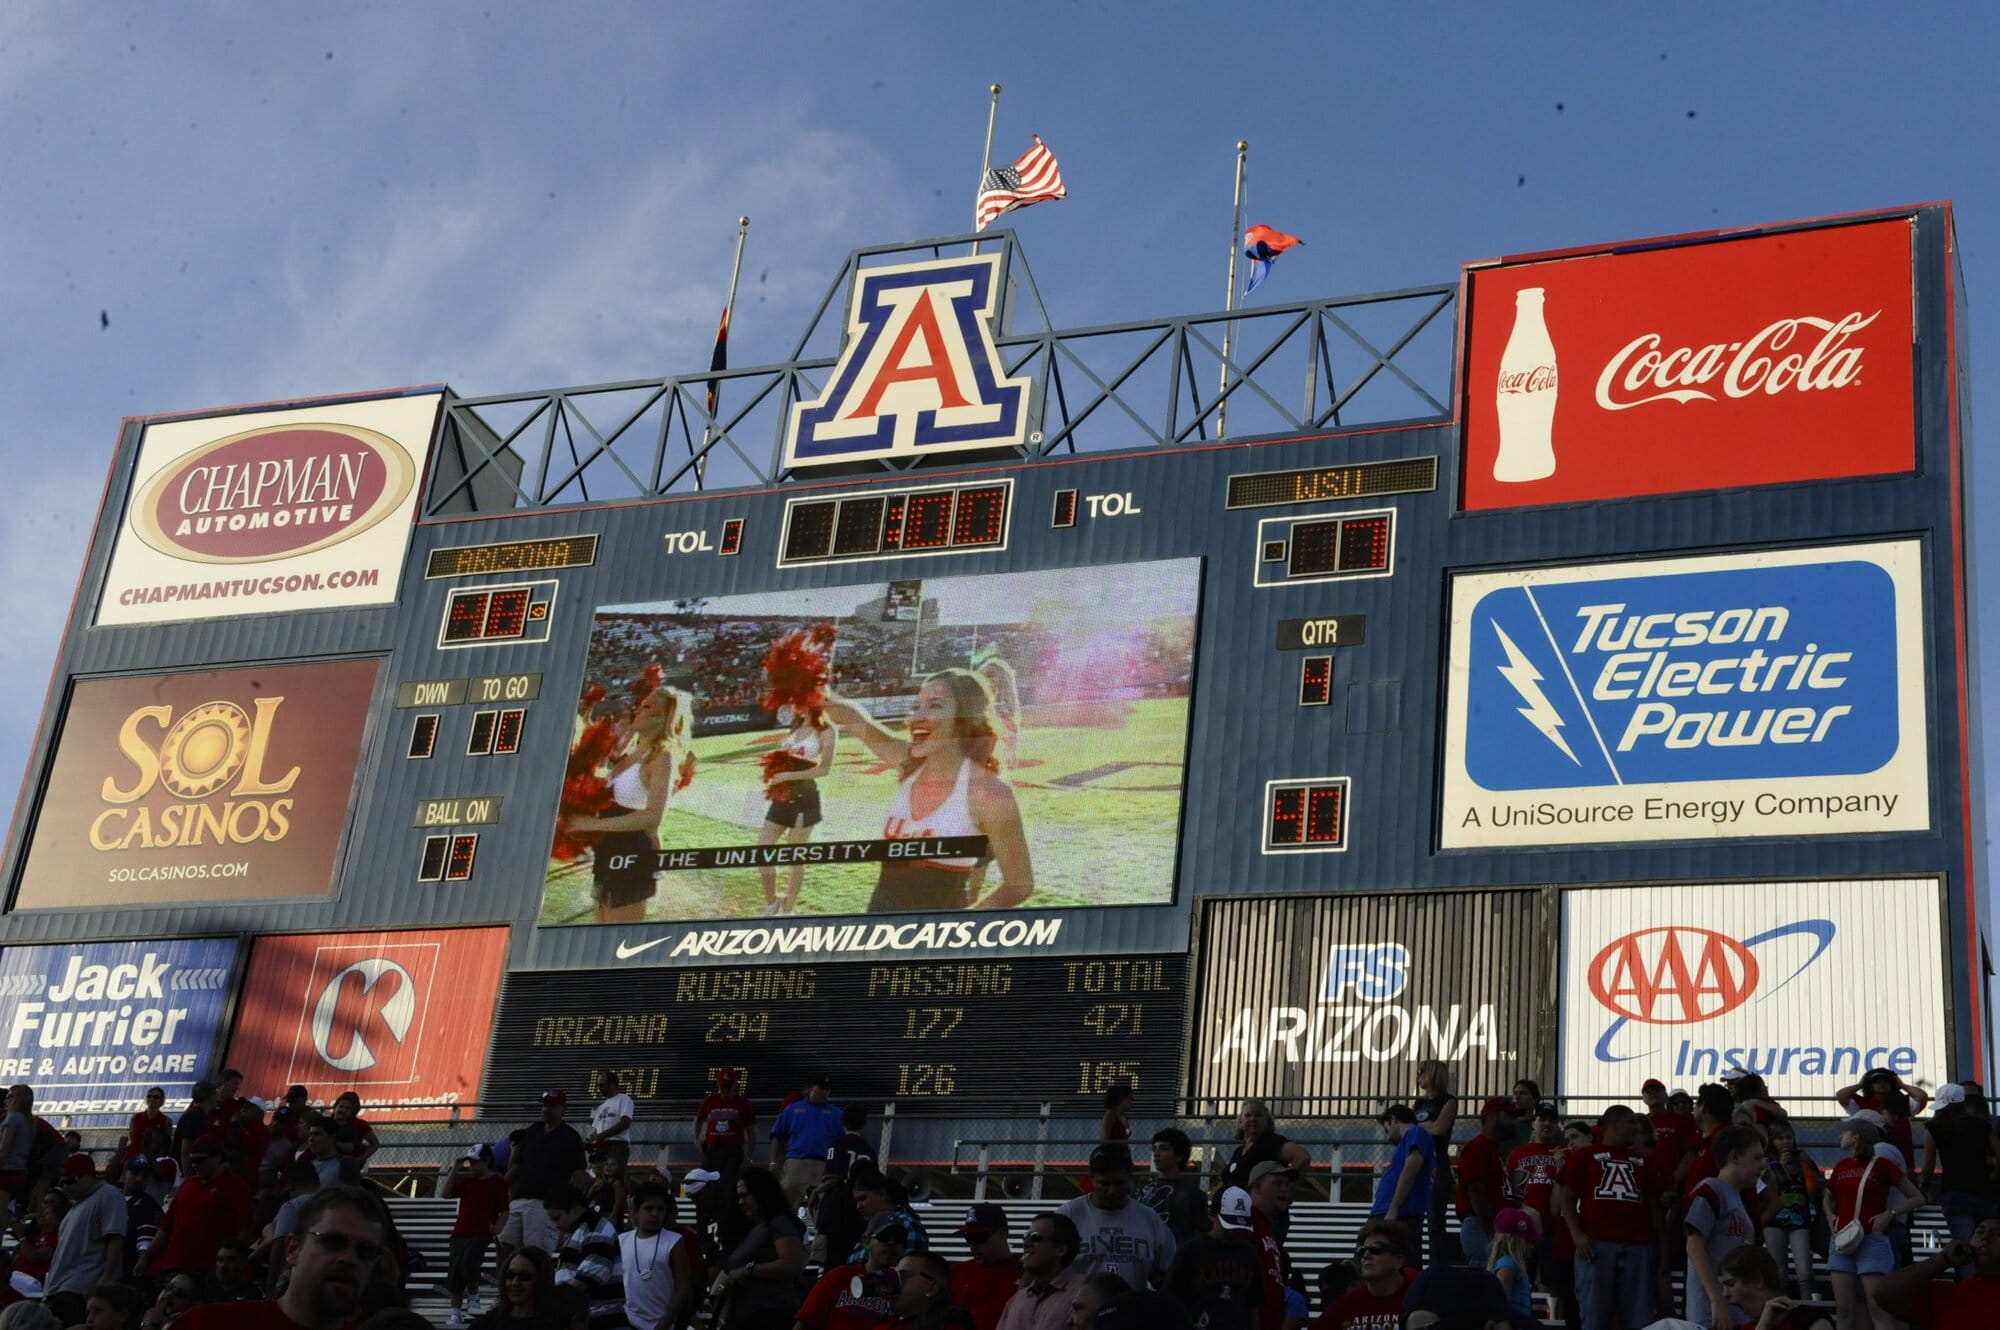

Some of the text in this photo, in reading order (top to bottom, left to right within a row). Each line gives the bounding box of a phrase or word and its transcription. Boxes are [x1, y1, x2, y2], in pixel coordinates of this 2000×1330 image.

[1595, 310, 1881, 410] Coca-Cola
[1498, 365, 1557, 394] Coca-Cola
[179, 452, 368, 515] CHAPMAN
[1295, 469, 1362, 500] WSU
[175, 504, 353, 536] AUTOMOTIVE
[1086, 492, 1141, 518] TOL
[455, 541, 570, 574] ARIZONA
[665, 530, 713, 554] TOL
[120, 569, 379, 606] CHAPMANTUCSON.COM
[451, 591, 529, 638] 48
[1302, 620, 1338, 645] QTR
[1572, 603, 1789, 653] Tucson
[483, 676, 529, 700] TO GO
[1593, 643, 1853, 701] Electric
[414, 682, 450, 705] DWN
[1616, 702, 1852, 752] Power
[102, 696, 301, 804] SOL
[90, 799, 293, 850] CASINOS
[425, 800, 489, 825] BALL ON
[1462, 793, 1898, 828] A UniSource Energy Company
[108, 863, 248, 882] SOLCASINOS.COM
[609, 841, 962, 871] OF THE UNIVERSITY BELL.
[669, 919, 1063, 957] ARIZONAWILDCATS.COM
[48, 953, 171, 1002] Jack
[675, 960, 1171, 1002] RUSHING PASSING TOTAL
[1318, 942, 1410, 1003] FS
[1605, 927, 1743, 1023] AAA
[8, 1002, 188, 1049] Furrier
[533, 1004, 1144, 1046] ARIZONA 294 177 471
[1212, 1004, 1498, 1063] ARIZONA
[38, 1057, 55, 1076] &
[62, 1056, 127, 1076] AUTO
[133, 1054, 197, 1073] CARE
[1675, 1040, 1917, 1077] Insurance
[896, 1064, 956, 1095] 126
[1353, 1313, 1400, 1325] ARIZON
